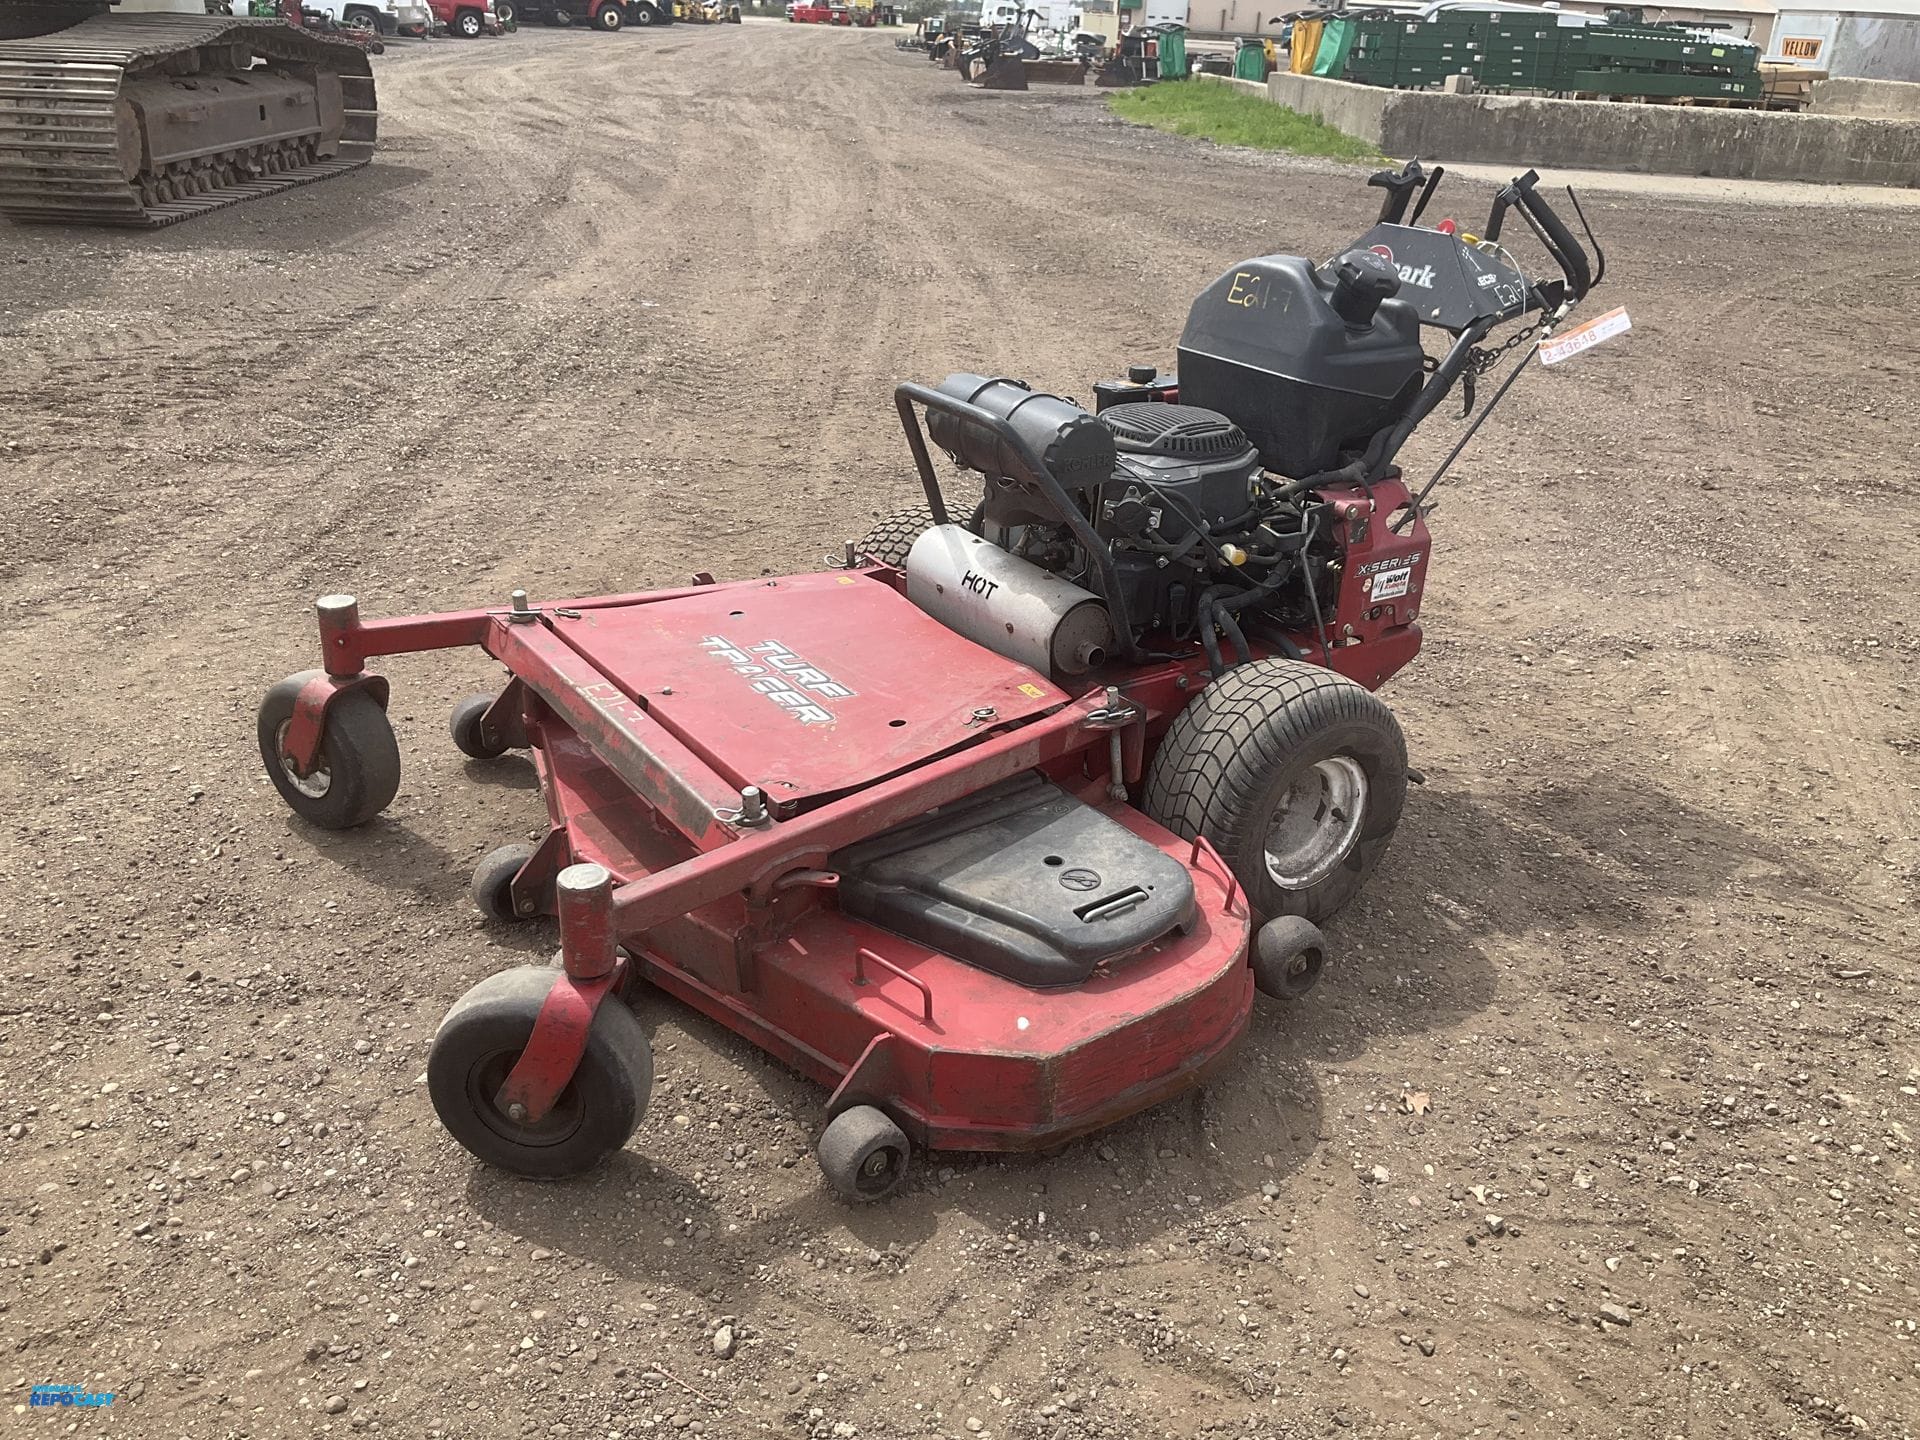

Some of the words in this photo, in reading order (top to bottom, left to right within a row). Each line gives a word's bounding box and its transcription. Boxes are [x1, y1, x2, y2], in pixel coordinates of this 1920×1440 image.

[1784, 40, 1819, 57] YELLOW
[961, 570, 999, 600] HOT
[699, 635, 837, 726] TRACER
[747, 639, 858, 699] TURF
